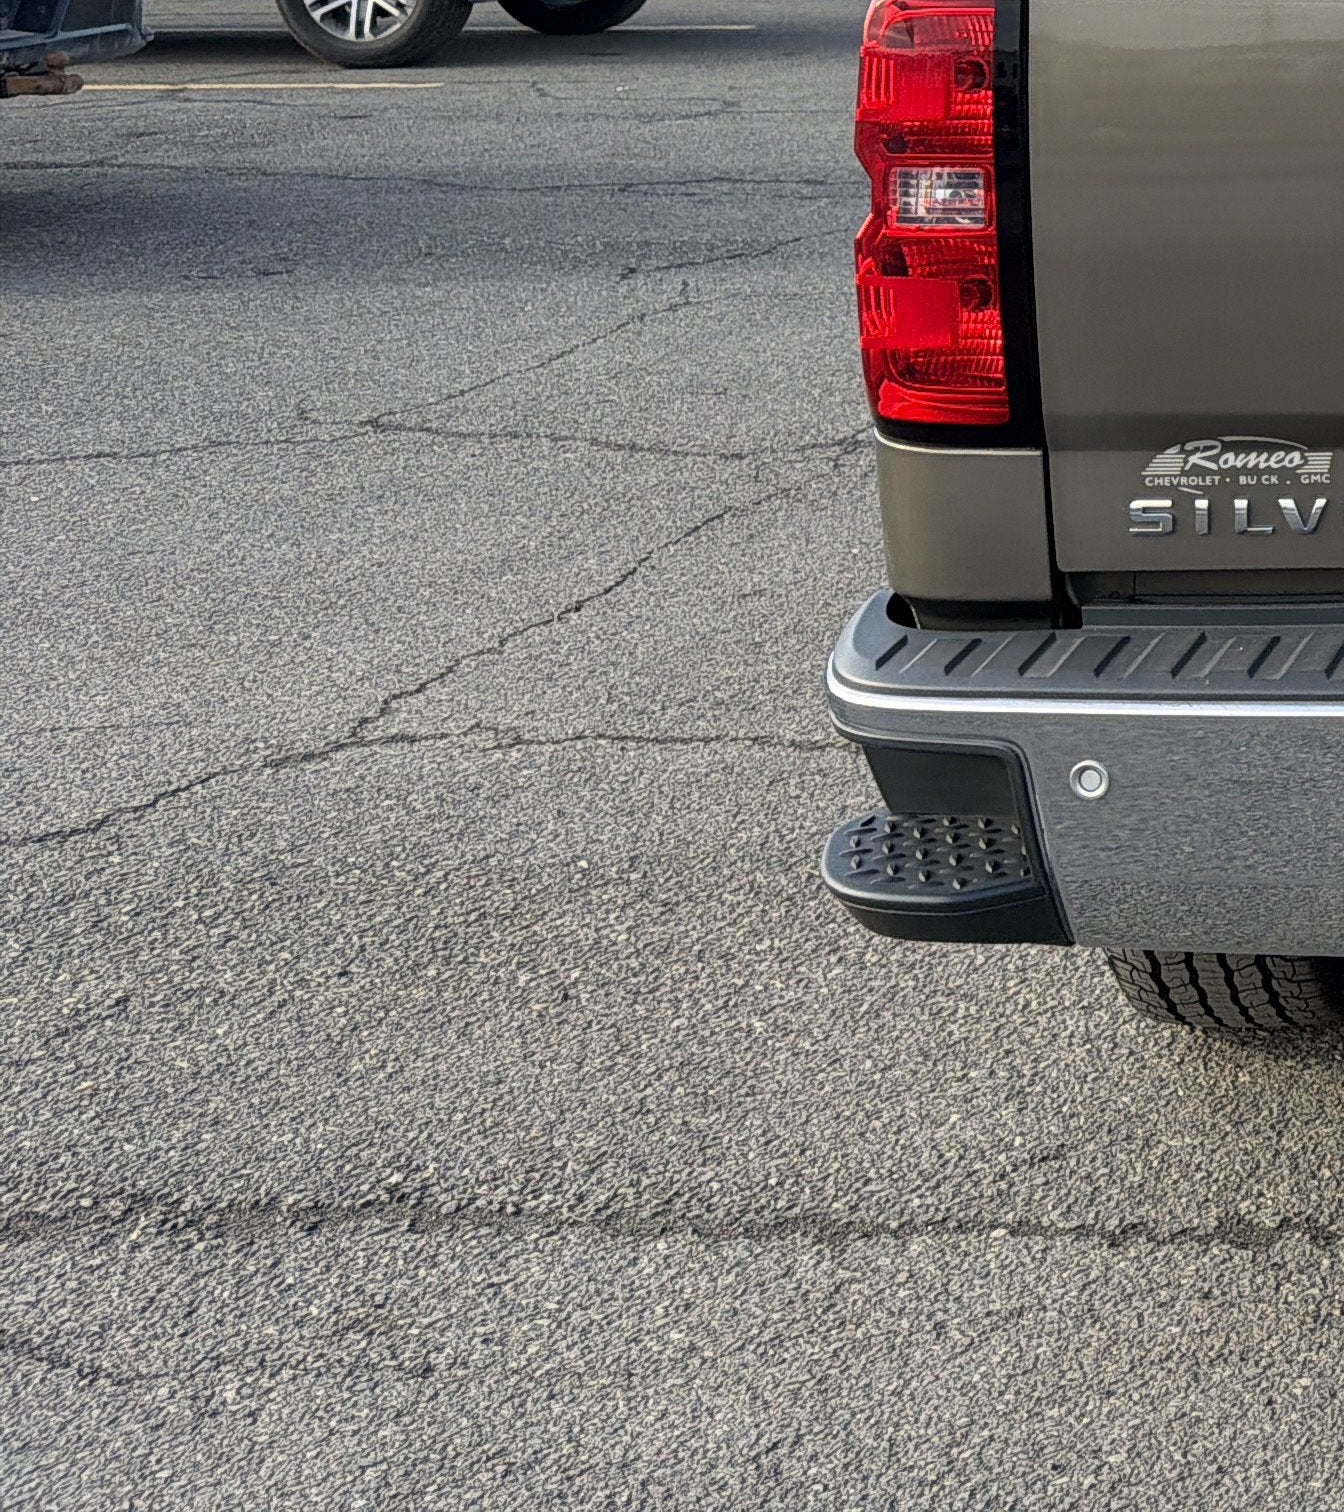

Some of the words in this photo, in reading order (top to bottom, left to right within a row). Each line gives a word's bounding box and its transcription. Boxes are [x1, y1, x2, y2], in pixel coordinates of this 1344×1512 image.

[1183, 439, 1305, 471] Romeo
[1144, 475, 1222, 487] CHEVROLET
[1300, 473, 1331, 484] GMC
